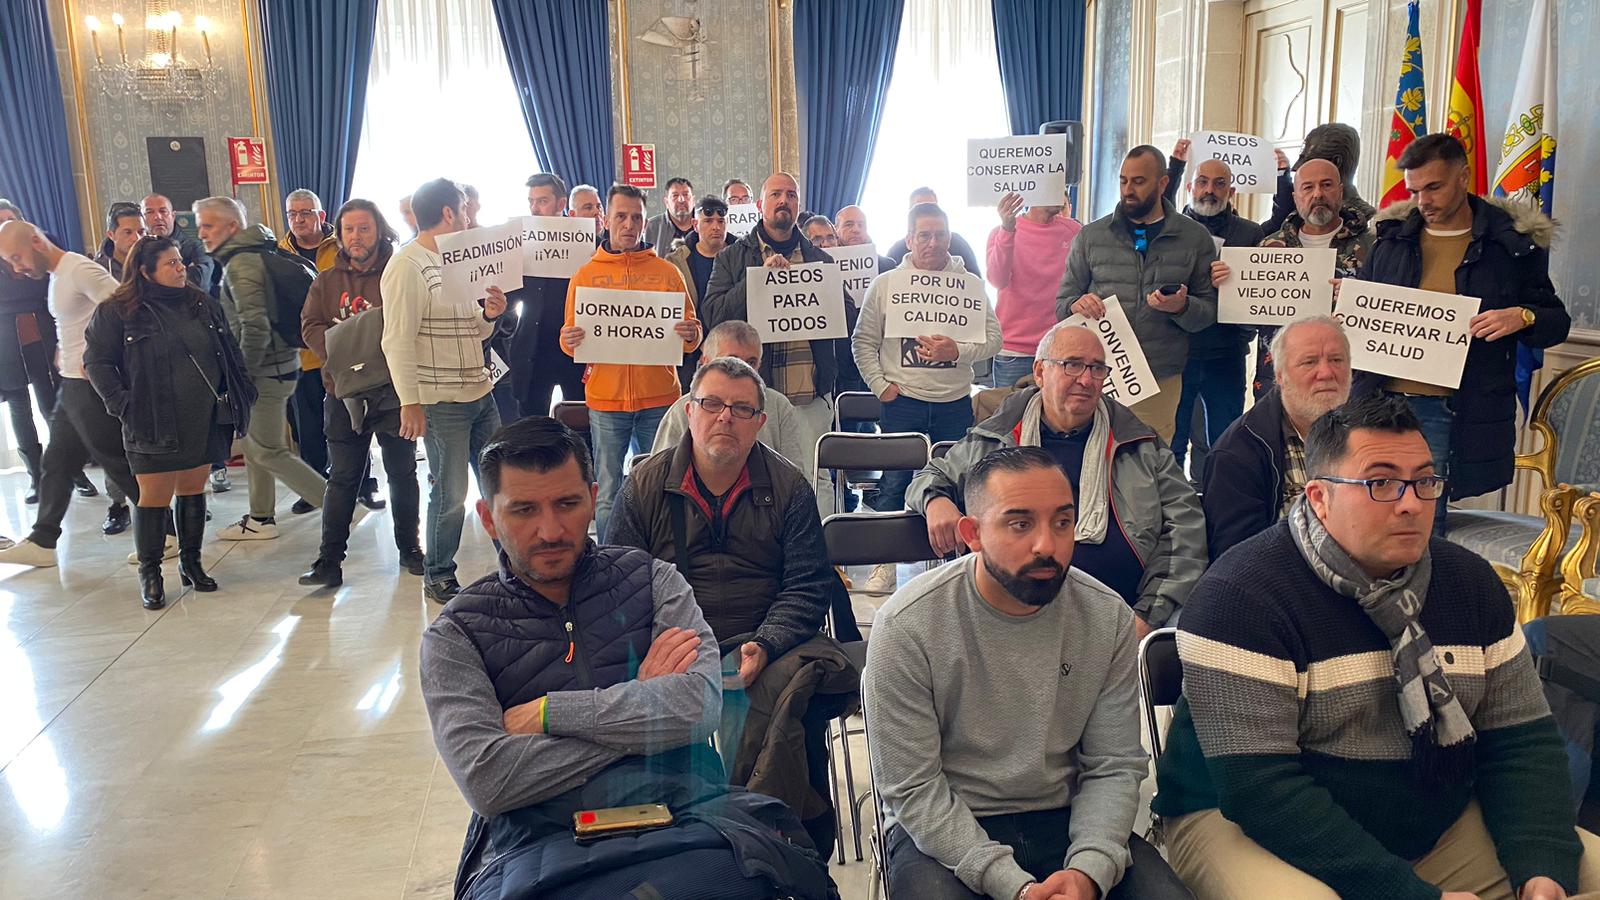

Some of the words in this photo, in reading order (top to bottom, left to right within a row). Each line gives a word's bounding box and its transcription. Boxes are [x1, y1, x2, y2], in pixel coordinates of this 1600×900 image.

[1207, 134, 1258, 147] ASEOS
[979, 146, 1052, 159] QUEREMOS
[1213, 152, 1252, 166] PARA
[967, 163, 1045, 176] CONSERVAR
[1048, 163, 1065, 173] LA
[994, 180, 1036, 192] SALUD
[523, 230, 594, 243] EADMISIÓN
[442, 235, 522, 265] READMISIÓN
[535, 249, 569, 260] ¡¡YA!!
[1249, 253, 1304, 264] QUIERO
[470, 261, 504, 282] ¡¡YA!!
[765, 268, 823, 285] ASEOS
[1240, 270, 1296, 281] LLEGAR
[1299, 271, 1310, 281] A
[911, 275, 941, 287] POR
[946, 277, 965, 290] UN
[773, 292, 820, 308] PARA
[1237, 288, 1277, 298] VIEJO
[1281, 288, 1311, 299] CON
[891, 293, 959, 307] SERVICIO
[963, 298, 982, 311] DE
[1355, 295, 1456, 321] QUEREMOS
[576, 303, 656, 319] JORNADA
[661, 307, 682, 319] DE
[1249, 305, 1296, 316] SALUD
[768, 315, 827, 333] TODOS
[904, 311, 968, 327] CALIDAD
[593, 325, 602, 337] 8
[607, 325, 664, 339] HORAS
[1335, 313, 1441, 341] CONSERVAR
[1445, 331, 1468, 346] LA
[1366, 339, 1424, 360] SALUD
[1098, 319, 1142, 396] ONVENIO
